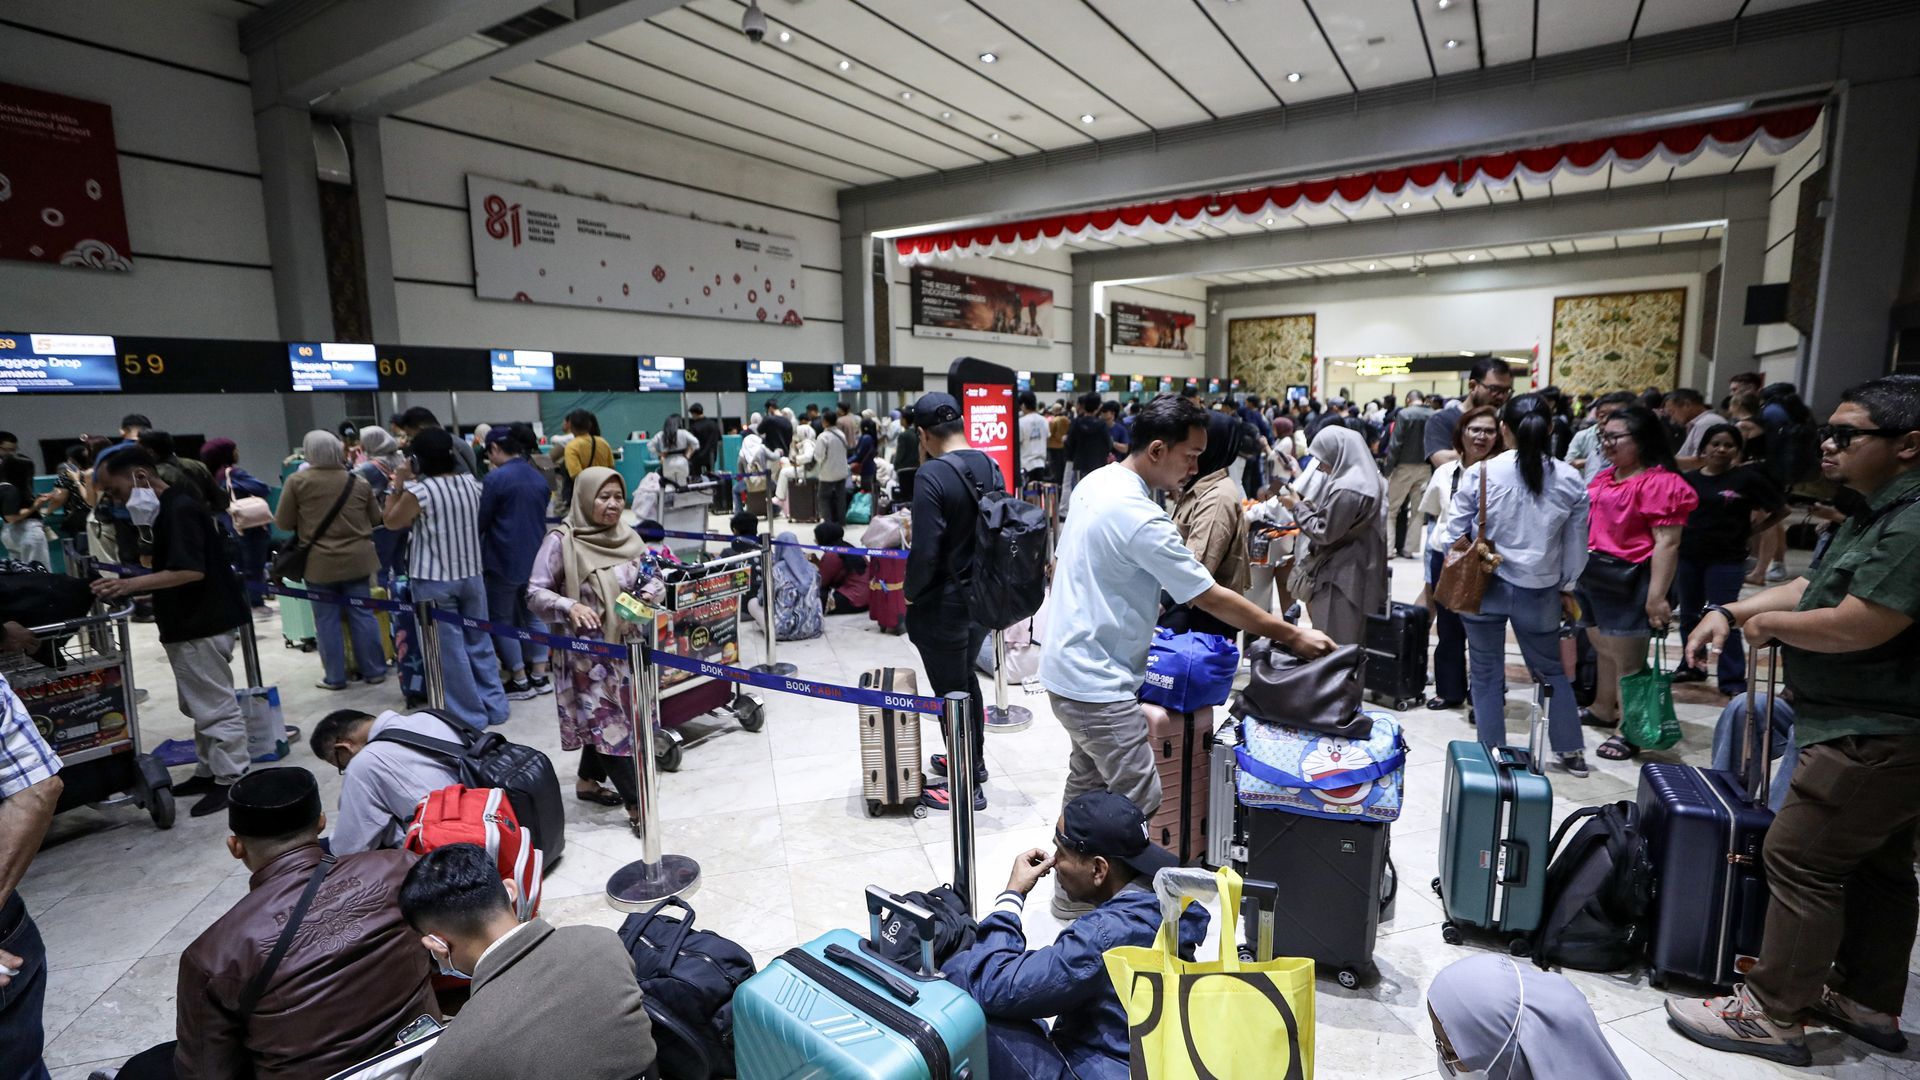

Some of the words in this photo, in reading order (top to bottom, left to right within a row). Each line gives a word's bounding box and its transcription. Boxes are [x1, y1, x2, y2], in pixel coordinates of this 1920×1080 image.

[484, 194, 521, 247] 81
[124, 355, 164, 374] 59
[380, 359, 406, 376] 60
[556, 366, 571, 380] 61
[685, 369, 698, 382] 62
[970, 421, 1008, 443] EXPO
[571, 641, 590, 651] BOOK
[786, 680, 811, 693] BOOK
[811, 686, 842, 698] CABIN
[884, 696, 914, 709] BOOK
